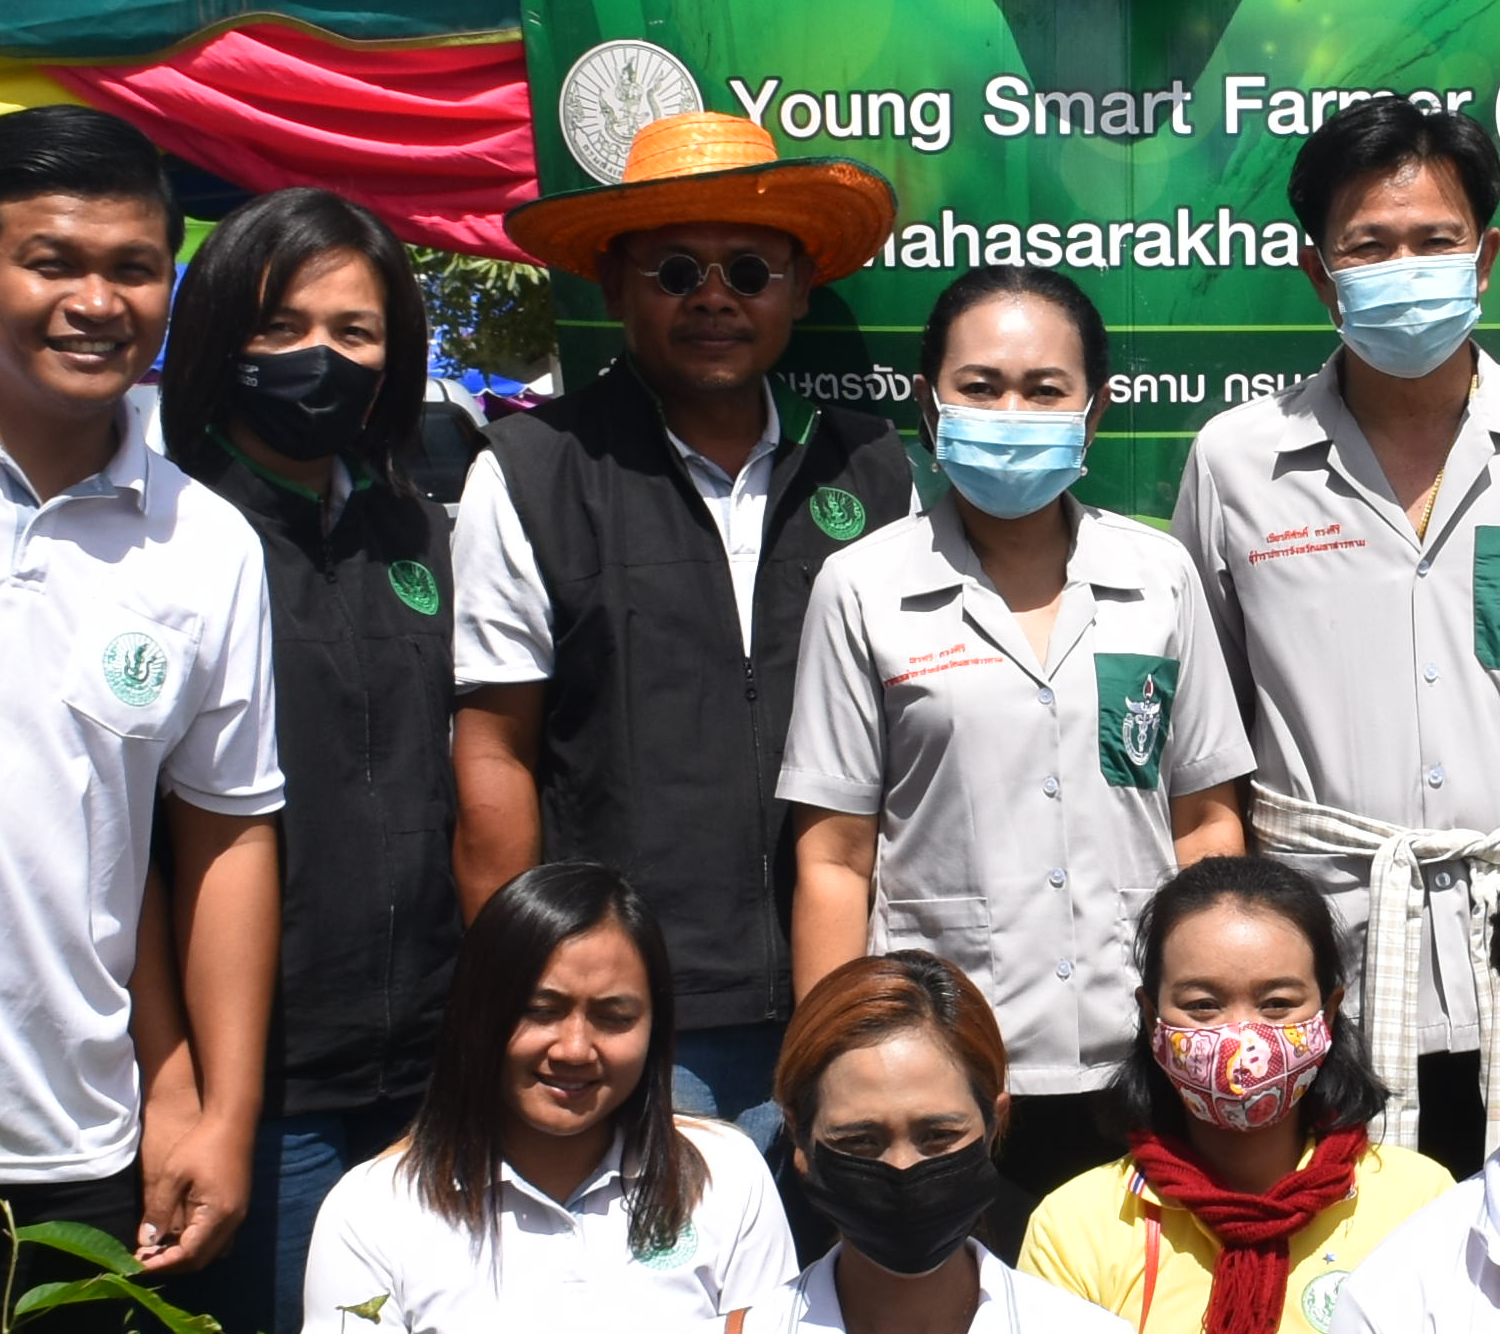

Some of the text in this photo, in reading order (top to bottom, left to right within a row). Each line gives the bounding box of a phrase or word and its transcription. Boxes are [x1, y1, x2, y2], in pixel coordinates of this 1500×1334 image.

[728, 75, 1474, 152] Young Smart Farer
[863, 207, 1315, 269] ahasarakha
